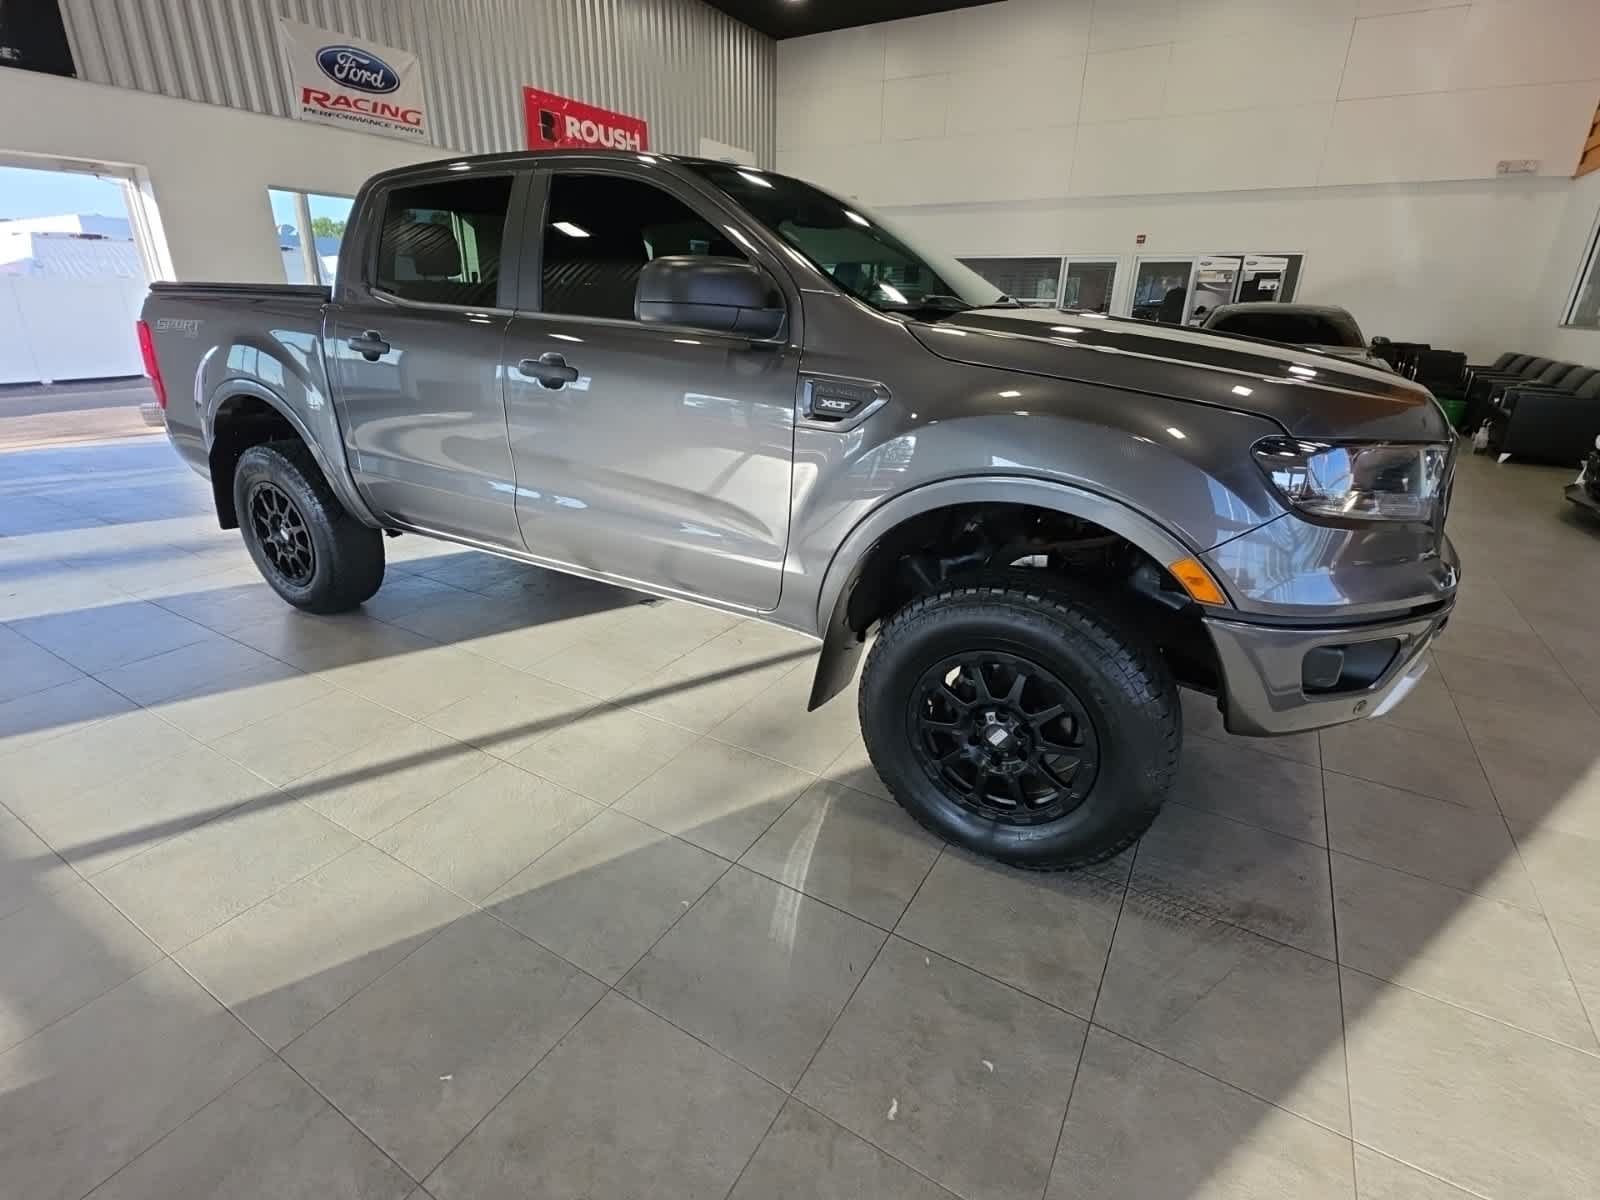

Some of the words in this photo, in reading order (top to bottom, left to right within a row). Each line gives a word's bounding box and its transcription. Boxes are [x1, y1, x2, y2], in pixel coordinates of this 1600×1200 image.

[335, 51, 385, 88] Ford
[302, 88, 423, 126] RACING
[303, 106, 392, 129] PERFORMANCE
[565, 116, 640, 151] ROUSH
[821, 399, 851, 409] XLT
